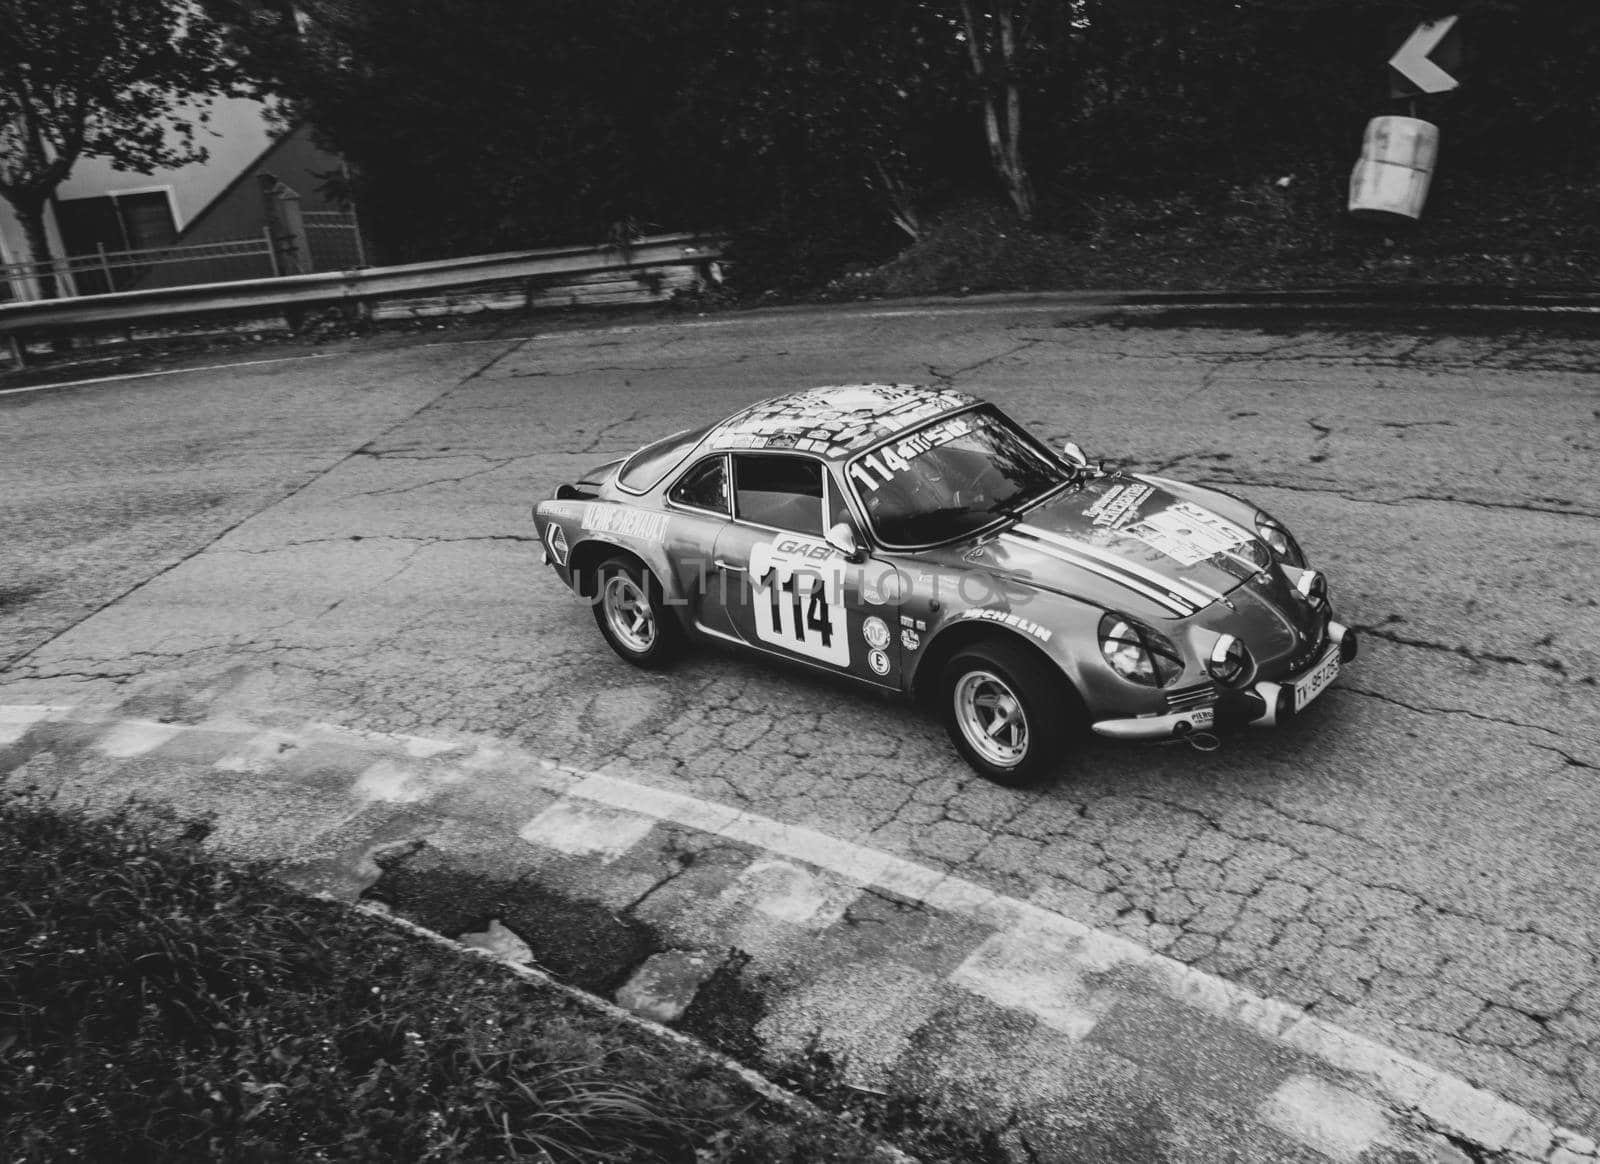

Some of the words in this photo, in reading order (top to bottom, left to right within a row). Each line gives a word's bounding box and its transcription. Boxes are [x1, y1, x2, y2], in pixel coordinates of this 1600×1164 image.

[850, 446, 911, 492] 114
[762, 567, 833, 648] 114
[962, 607, 1053, 643] MICHELIN
